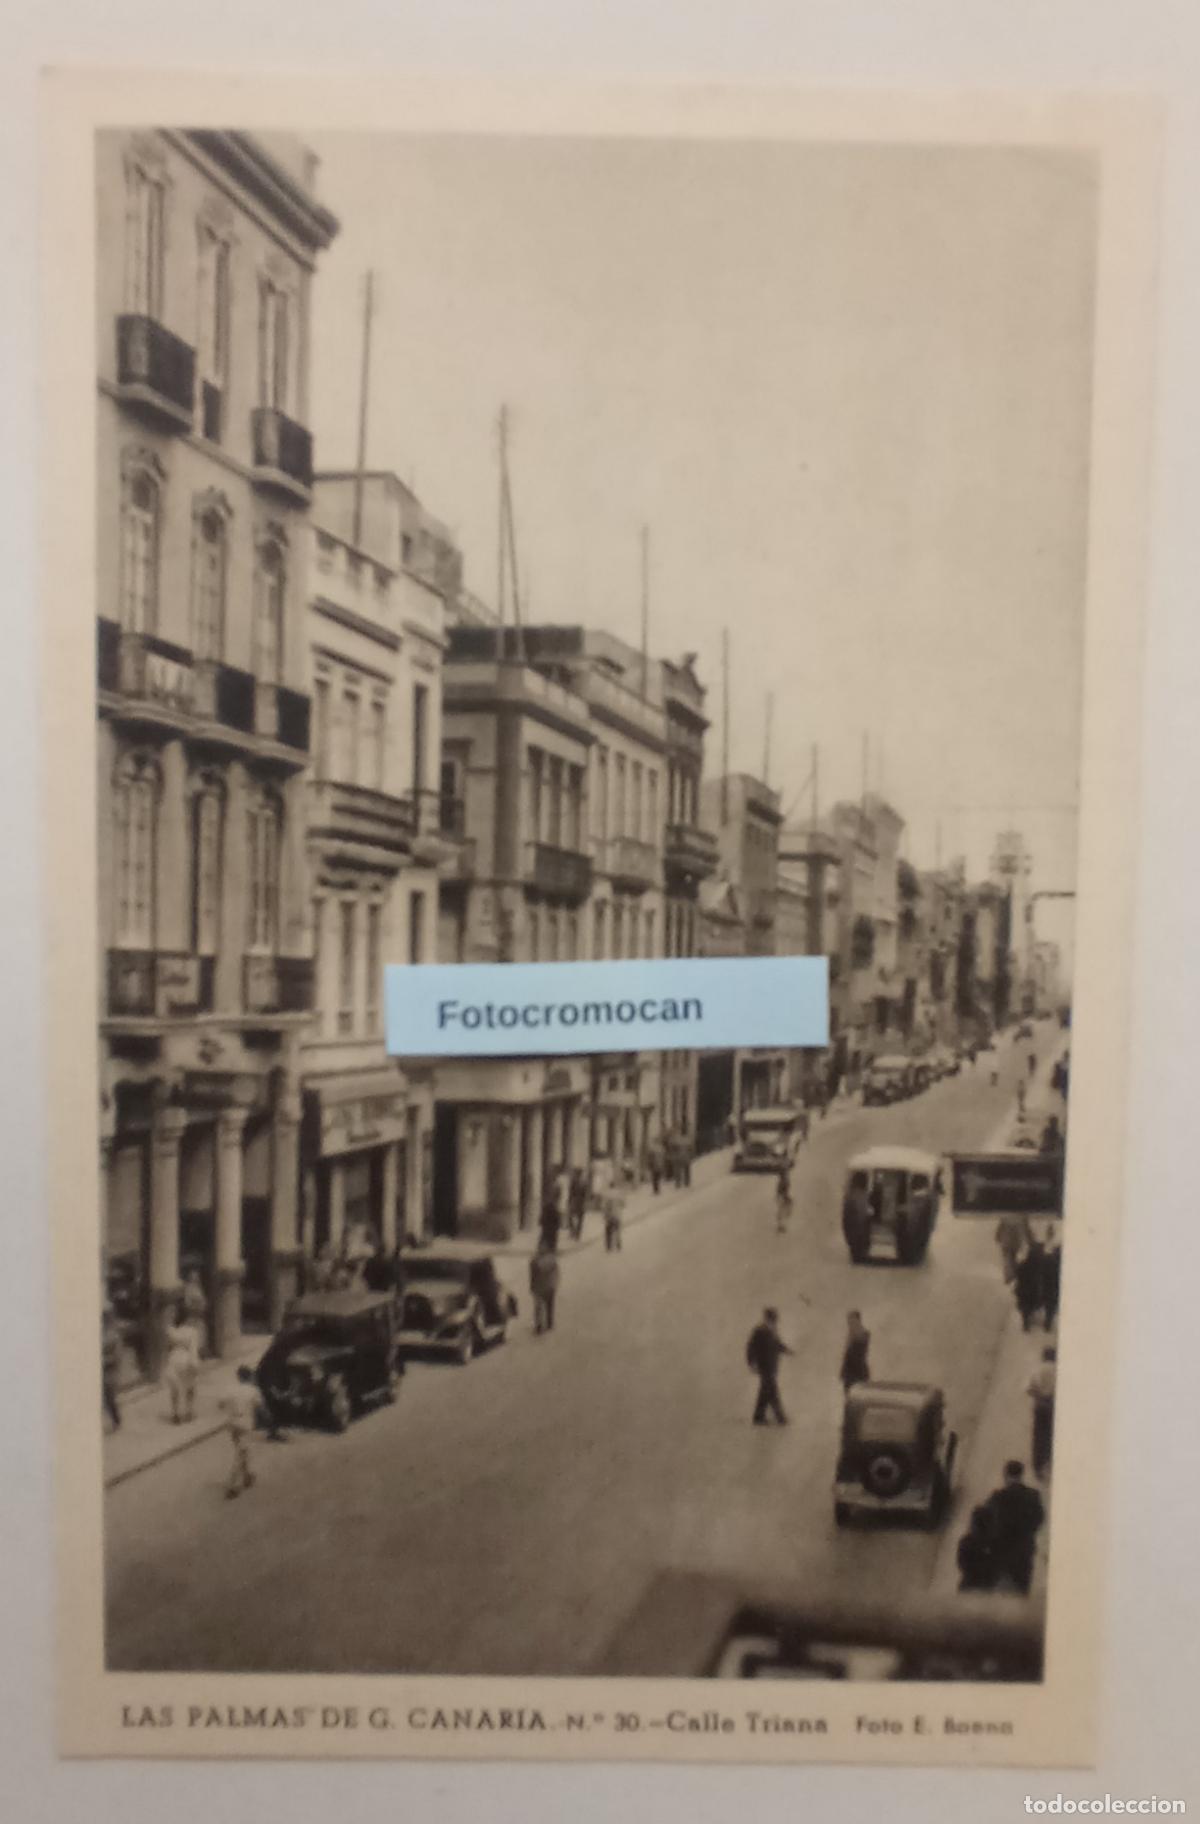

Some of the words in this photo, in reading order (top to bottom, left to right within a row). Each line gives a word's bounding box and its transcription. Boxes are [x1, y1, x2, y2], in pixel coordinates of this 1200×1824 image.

[437, 998, 703, 1030] Fotocromocan
[121, 1706, 174, 1728] LAS
[188, 1706, 308, 1728] PALMAS
[321, 1706, 359, 1729] DE
[368, 1707, 394, 1730] G.
[746, 1711, 829, 1734] Triana
[856, 1714, 903, 1735] Foto
